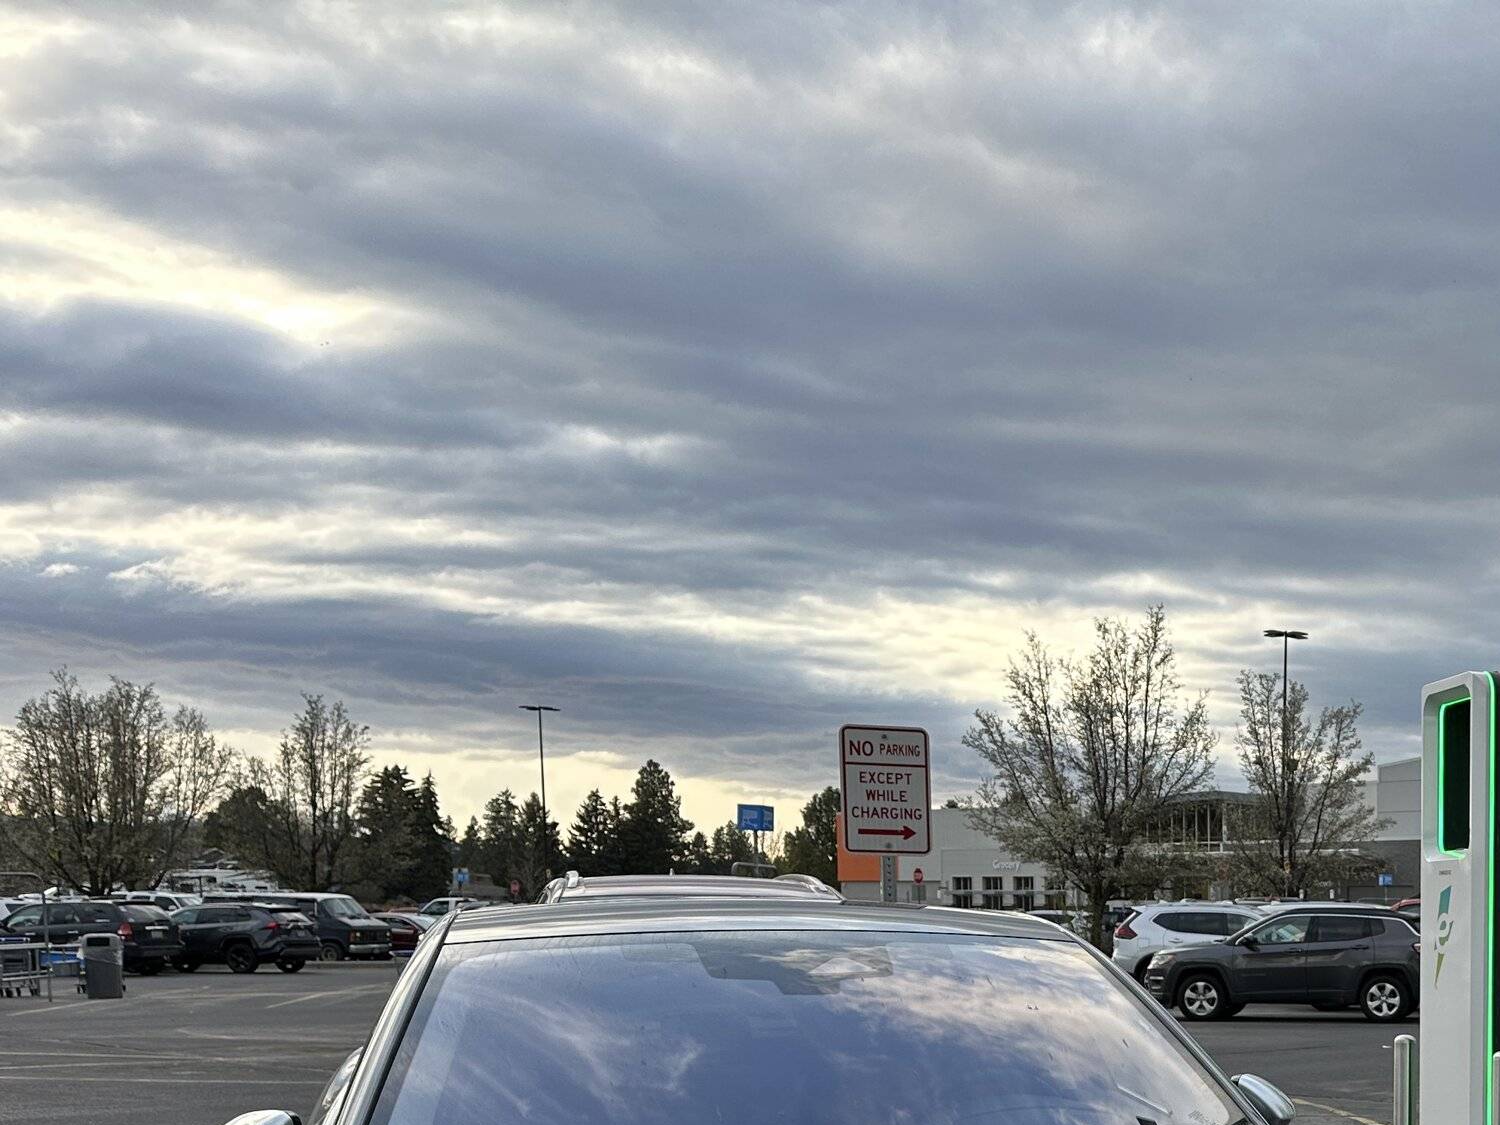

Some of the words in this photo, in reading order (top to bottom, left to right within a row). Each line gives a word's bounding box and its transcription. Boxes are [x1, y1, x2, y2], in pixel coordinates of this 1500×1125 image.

[849, 740, 873, 756] NO
[879, 743, 920, 758] PARKING
[859, 772, 912, 785] EXCEPT
[866, 789, 908, 803] WHILE
[852, 806, 922, 821] CHARGING
